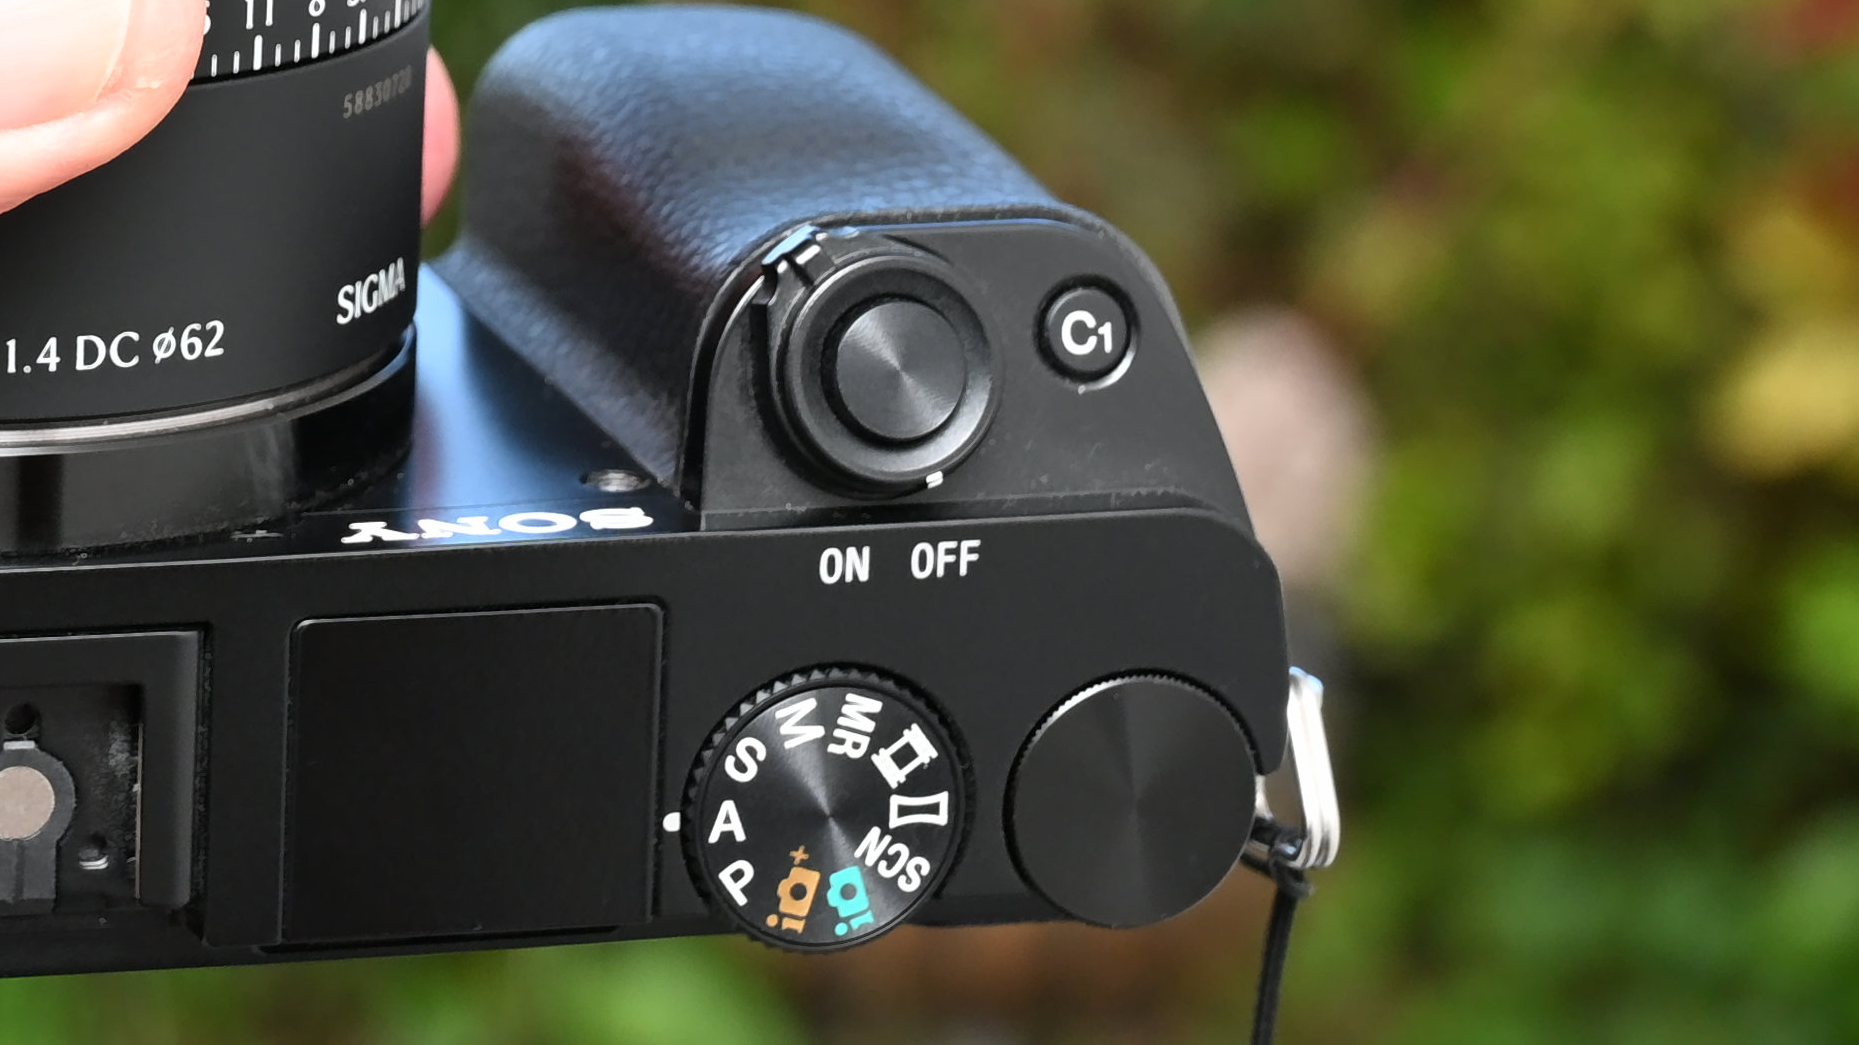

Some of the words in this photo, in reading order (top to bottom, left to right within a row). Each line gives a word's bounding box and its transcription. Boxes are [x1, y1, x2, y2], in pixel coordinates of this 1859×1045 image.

[336, 257, 406, 325] SIGMA
[75, 331, 140, 371] DC
[1061, 309, 1113, 355] C1
[340, 507, 654, 544] SONY
[819, 545, 871, 584] ON
[910, 539, 982, 580] OFF
[775, 697, 825, 750] M
[827, 692, 883, 759] MR
[724, 736, 767, 783] S
[708, 799, 747, 843] A
[718, 859, 754, 906] P
[854, 826, 931, 893] SCN
